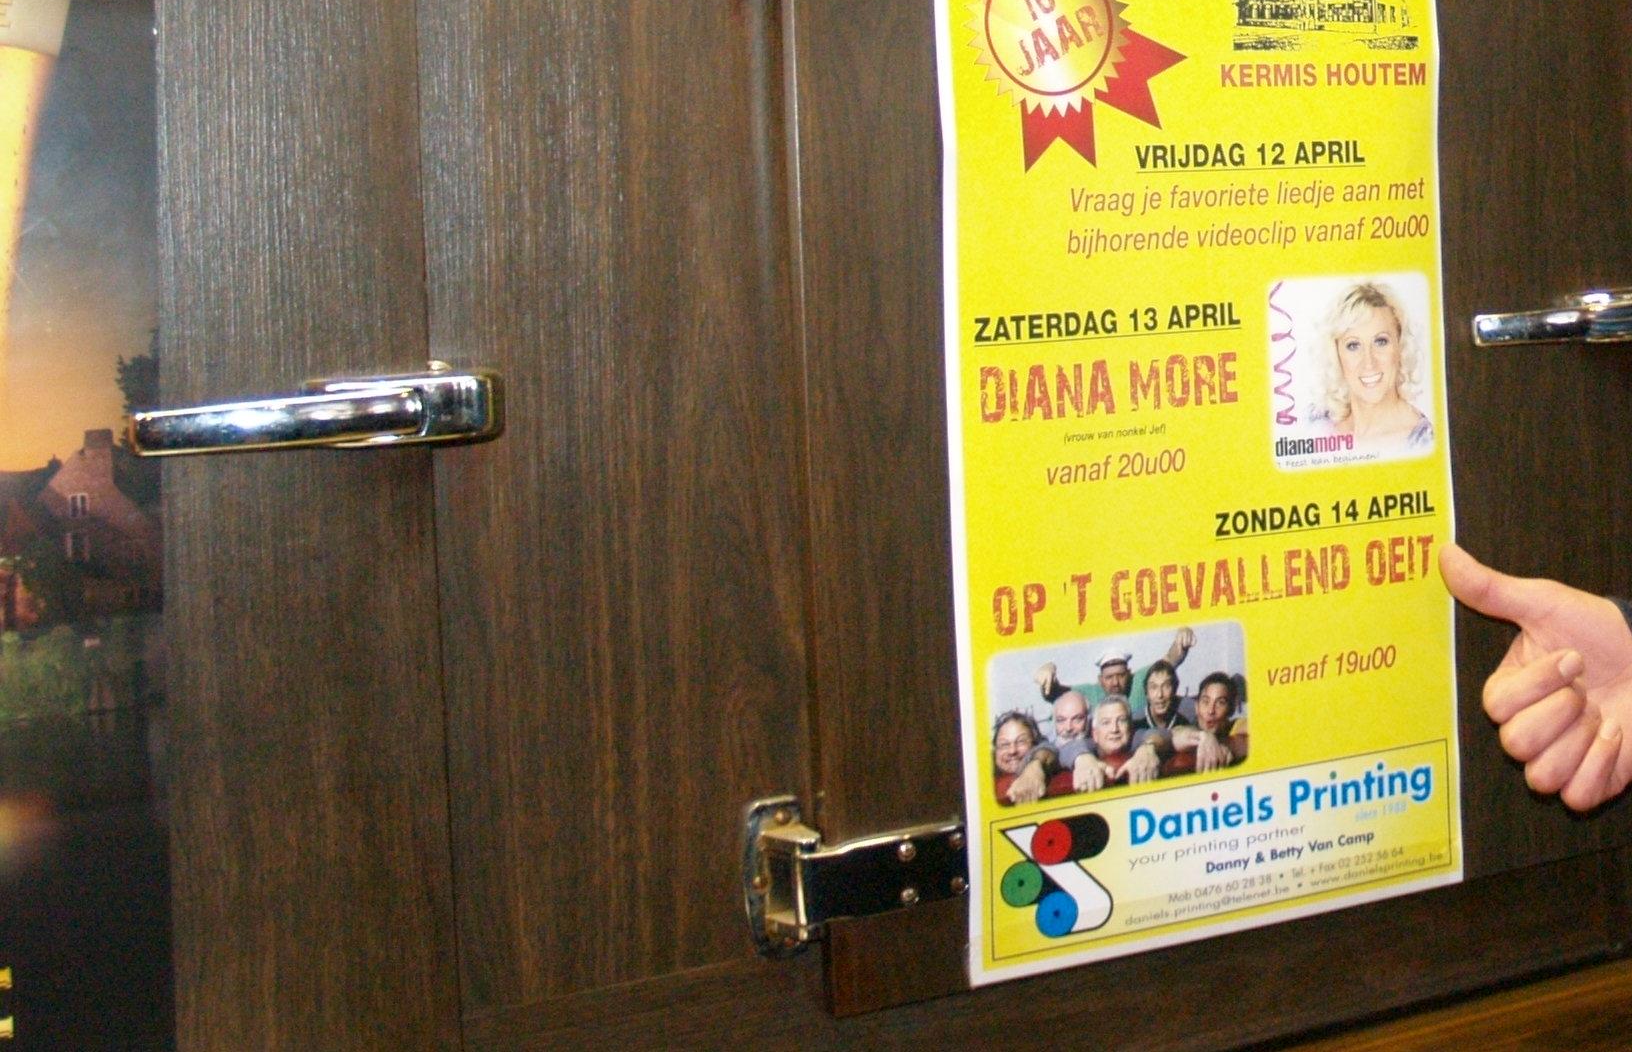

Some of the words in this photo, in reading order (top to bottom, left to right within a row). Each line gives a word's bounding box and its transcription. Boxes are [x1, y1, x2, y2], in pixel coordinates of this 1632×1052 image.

[1017, 4, 1105, 78] JAAR
[1220, 63, 1318, 88] KERMIS
[1326, 62, 1427, 87] HOUTEM
[1135, 142, 1246, 170] VRIJDAG
[1257, 142, 1286, 166] 12
[1295, 140, 1365, 165] APRIL
[1069, 186, 1134, 215] Vraag
[1140, 186, 1163, 213] je
[1169, 184, 1269, 210] favoriete
[1276, 180, 1335, 208] liedje
[1342, 184, 1381, 202] aan
[1387, 180, 1425, 201] met
[1067, 228, 1189, 260] bijhorende
[1197, 222, 1297, 249] videoclip
[1305, 220, 1364, 242] vanaf
[1370, 215, 1429, 240] 20u00
[974, 308, 1117, 343] ZATERDAG
[1129, 307, 1158, 331] 13
[1168, 301, 1241, 329] APRIL
[979, 356, 1116, 424] DIANA
[1130, 352, 1239, 412] MORE
[1097, 430, 1114, 440] van
[1116, 425, 1147, 437] nonkel
[1275, 433, 1354, 457] dianamore
[1046, 454, 1111, 486] vanaf
[1118, 448, 1186, 478] 20u00
[1215, 503, 1321, 536] ZONDAG
[1331, 499, 1360, 525] 14
[1367, 492, 1435, 520] APRIL
[992, 581, 1047, 636] OP
[1063, 573, 1092, 626] 'T
[1110, 542, 1351, 621] GOEVALLEND
[1365, 534, 1434, 587] OEIT
[1267, 660, 1328, 687] vanaf
[1335, 645, 1397, 677] 19u00
[1128, 785, 1274, 847] Daniels
[1289, 761, 1433, 817] Printing
[1128, 852, 1167, 870] your
[1174, 836, 1241, 865] printing
[1246, 824, 1306, 851] partner
[1205, 853, 1250, 874] Danny
[1255, 851, 1266, 865] &
[1270, 844, 1304, 862] Betty
[1308, 838, 1334, 853] Van
[1338, 830, 1375, 847] Camp
[1167, 890, 1192, 905] Mob
[1194, 884, 1223, 899] 0476
